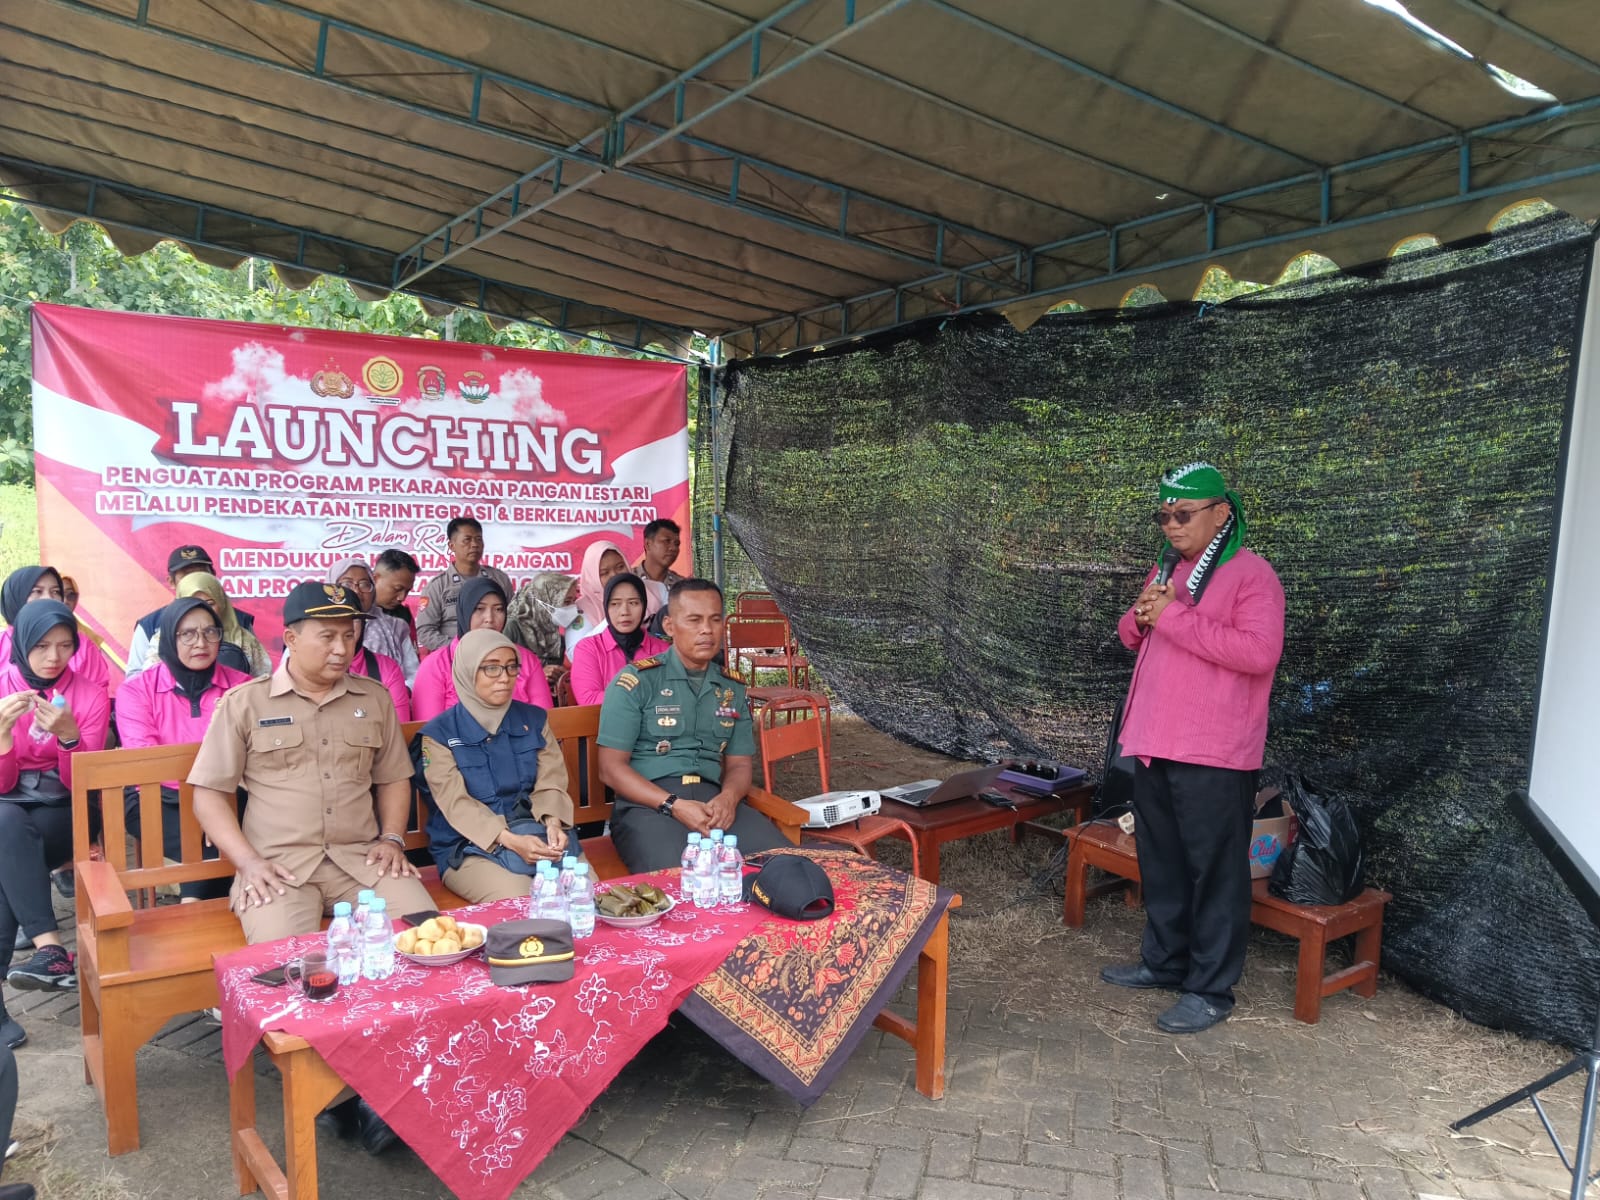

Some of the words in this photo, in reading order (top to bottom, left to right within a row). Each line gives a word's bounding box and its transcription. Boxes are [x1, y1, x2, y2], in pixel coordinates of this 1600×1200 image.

[171, 401, 602, 475] LAUNCHING
[106, 466, 250, 488] PENGUATAN
[255, 473, 363, 493] PROGRAM
[368, 477, 504, 497] PEKARANGAN
[507, 483, 583, 500] PANGAN
[585, 486, 649, 501] LESTARI
[99, 494, 198, 513] MELALUI
[205, 497, 351, 517] PENDEKATAN
[355, 502, 492, 521] TERINTEGRASI
[498, 507, 507, 521] &
[513, 507, 656, 523] BERKELANJUTAN
[321, 519, 408, 549] Dalam
[493, 554, 569, 569] PANGAN
[222, 578, 253, 594] AN
